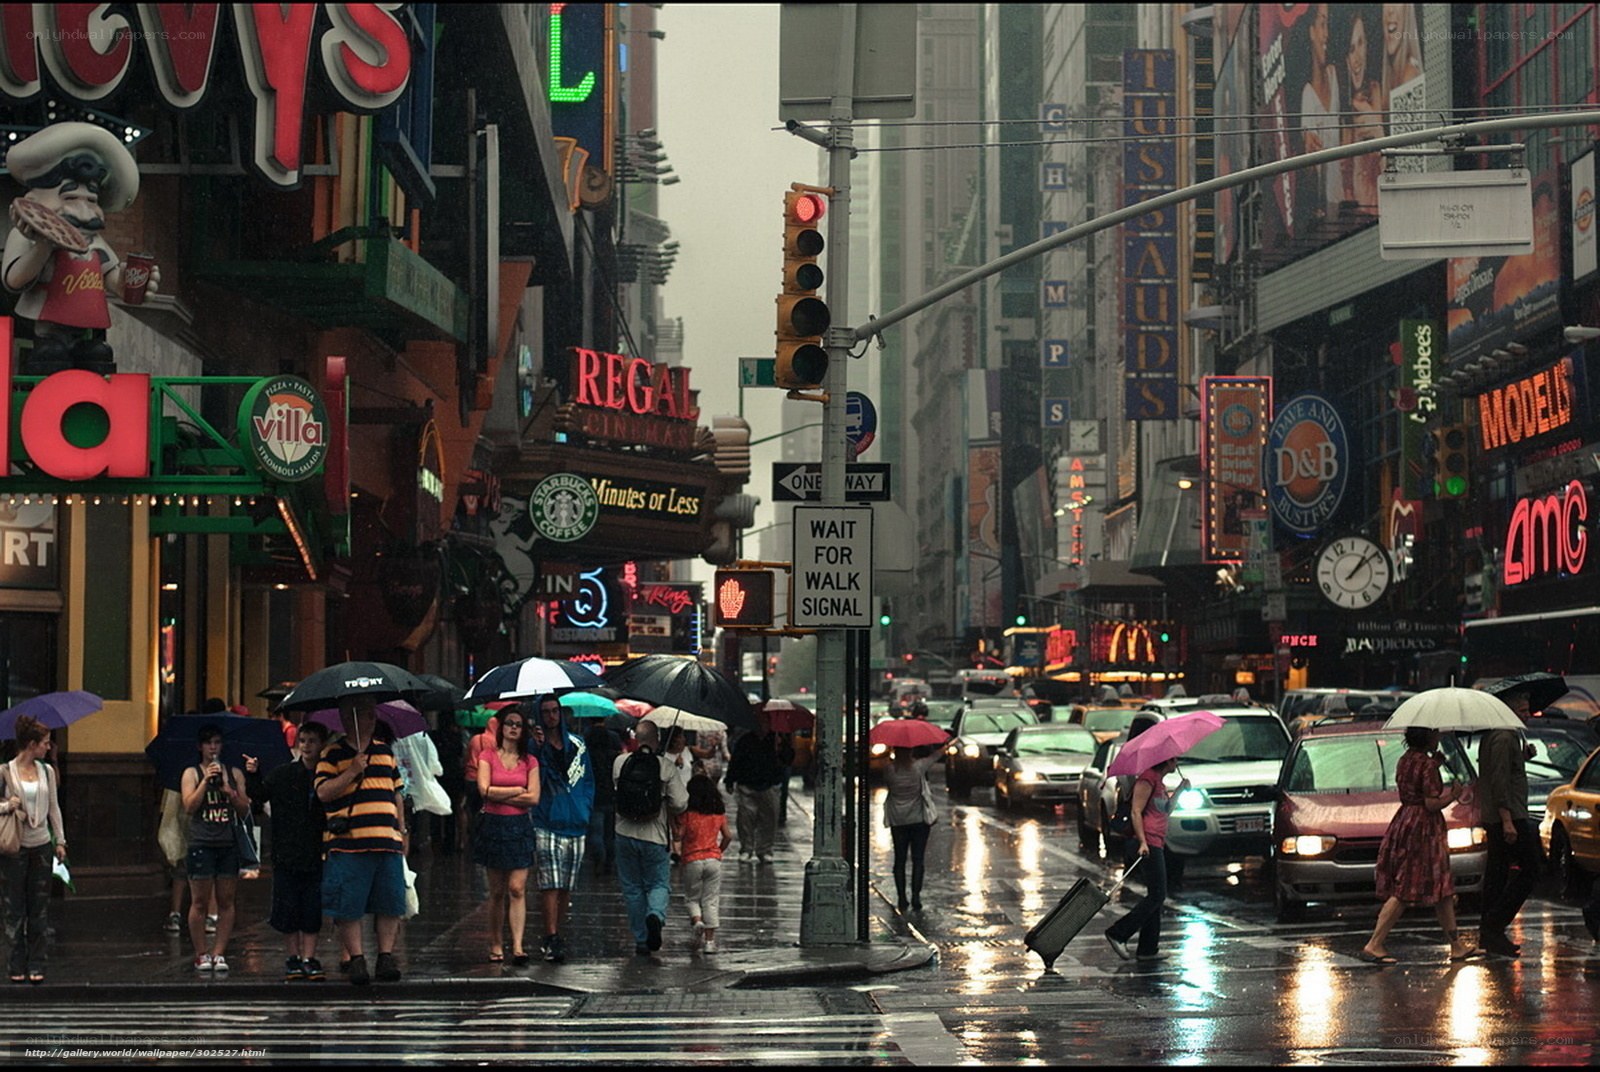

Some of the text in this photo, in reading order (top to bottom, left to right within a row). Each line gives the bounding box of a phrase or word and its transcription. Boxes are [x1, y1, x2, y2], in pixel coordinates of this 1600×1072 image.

[1131, 52, 1170, 418] TUSSAUDS
[265, 381, 316, 402] PIZZA PASTA
[575, 346, 700, 421] REGAL
[253, 407, 323, 446] villa
[1274, 402, 1338, 440] DAVE AND
[257, 445, 321, 476] STROMBOLI SALADS
[1274, 441, 1339, 487] D&B
[534, 476, 594, 507] STARBUCKS
[591, 478, 700, 515] Minutes or Less
[791, 473, 876, 490] ONE WAY
[540, 520, 588, 538] COFFEE
[810, 520, 857, 539] WAIT
[1504, 479, 1588, 586] AMC
[4, 530, 53, 567] RT
[814, 546, 852, 565] FOR
[805, 571, 860, 590] WALK
[802, 597, 863, 616] SIGNAL
[202, 808, 229, 822] LIVE
